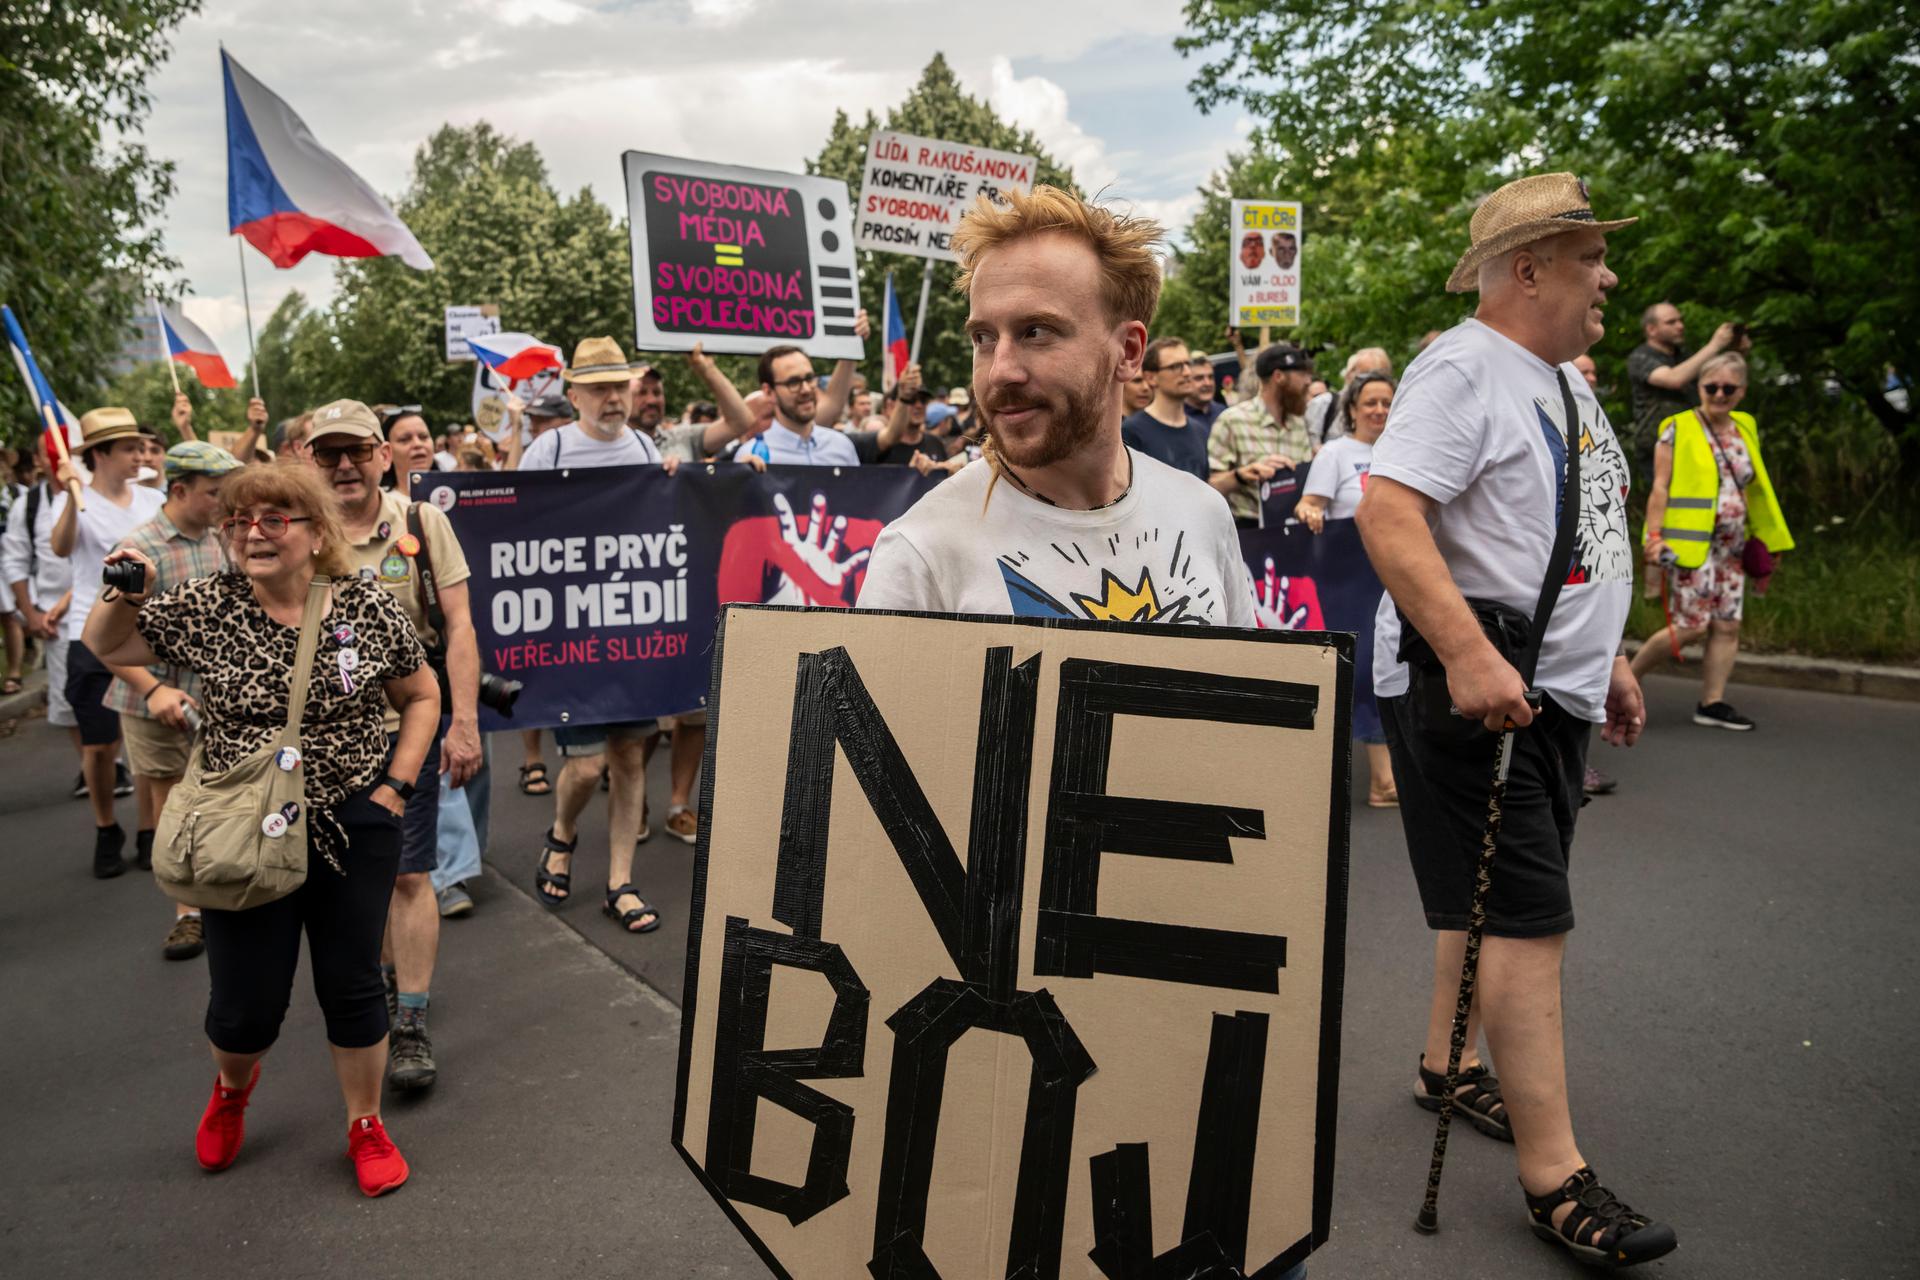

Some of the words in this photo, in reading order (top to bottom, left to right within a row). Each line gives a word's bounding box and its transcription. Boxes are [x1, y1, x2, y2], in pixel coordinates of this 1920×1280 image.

[875, 136, 909, 163] LÍDA
[918, 147, 1032, 183] RAKUŠANOVÁ
[654, 175, 791, 218] SVOBODNÁ
[870, 168, 968, 199] KOMENTÁŘE
[678, 208, 766, 248] MÉDIA
[866, 195, 954, 224] SVOBODNÁ
[1243, 207, 1258, 225] ČT
[1262, 215, 1269, 226] a
[862, 221, 919, 248] PROSÍM
[657, 262, 803, 301] SVOBODNÁ
[1270, 275, 1296, 286] OLDO
[653, 295, 816, 337] SPOLEČNOST
[490, 537, 587, 578] RUCE
[594, 524, 688, 571] PRYČ
[491, 587, 553, 636] OD
[565, 568, 688, 629] MÉDIÍ
[495, 634, 600, 672] VEŘEJNÉ
[607, 630, 689, 662] SLUŽBY
[772, 645, 1319, 998] NE
[705, 915, 1269, 1280] BOJ
